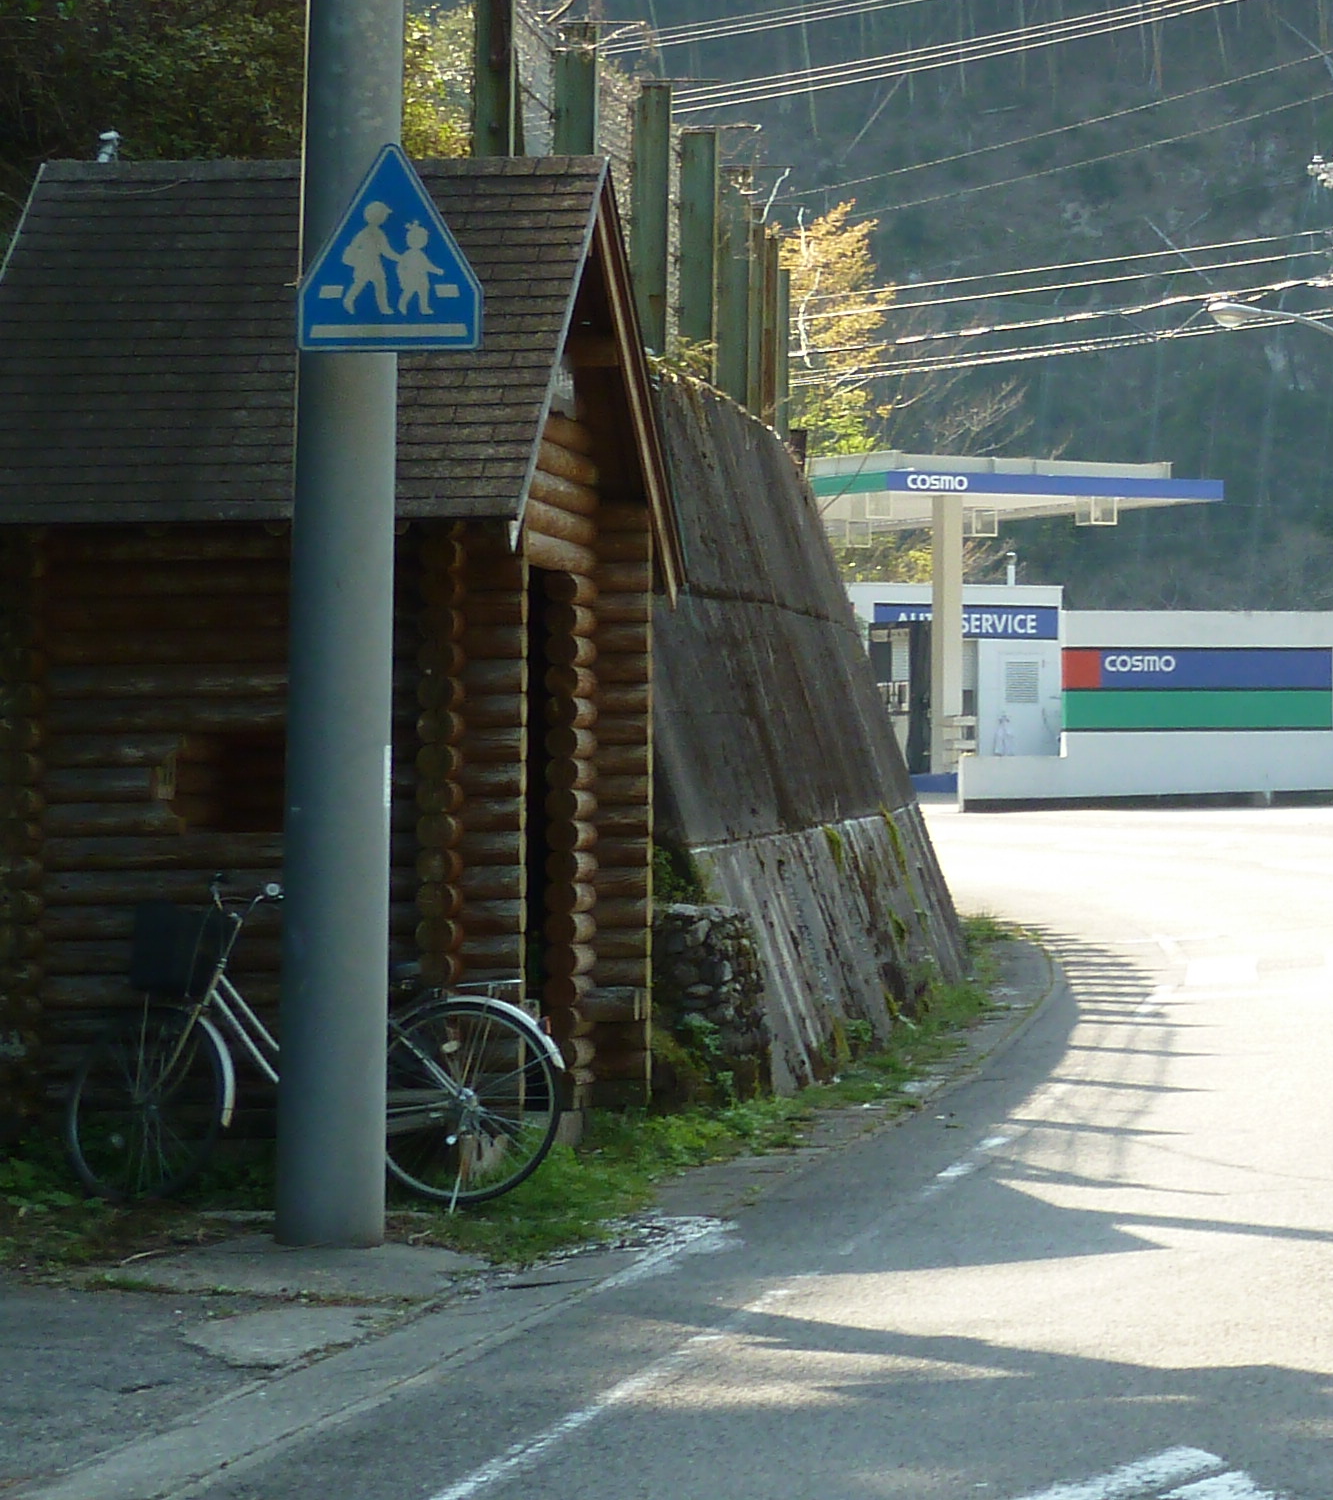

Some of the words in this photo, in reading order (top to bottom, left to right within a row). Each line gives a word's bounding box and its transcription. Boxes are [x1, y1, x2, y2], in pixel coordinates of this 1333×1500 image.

[906, 473, 969, 492] COSMO
[962, 612, 1037, 634] SERVICE
[1103, 654, 1176, 673] COSMO
